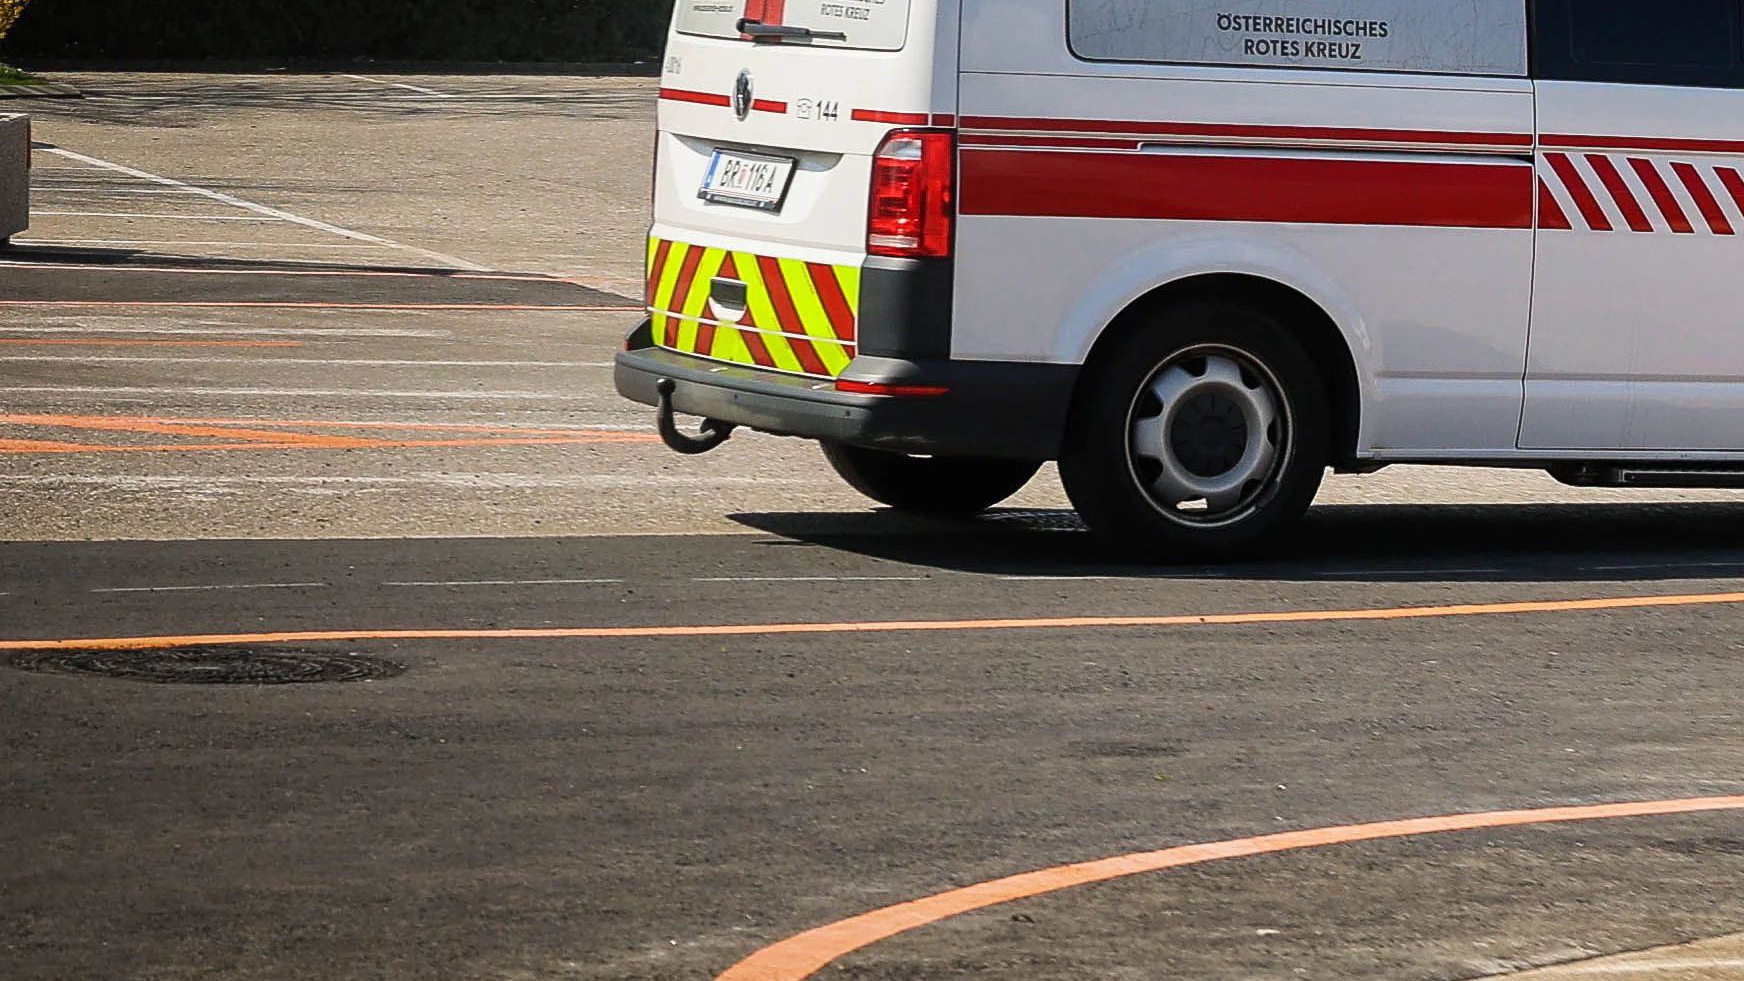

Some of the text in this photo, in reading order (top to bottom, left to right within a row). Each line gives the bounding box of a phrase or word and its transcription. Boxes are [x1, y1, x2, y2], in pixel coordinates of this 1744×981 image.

[1216, 12, 1389, 38] ÖSTERREICHISCHES
[1244, 38, 1362, 60] ROTES KREUZ
[816, 100, 839, 122] 144
